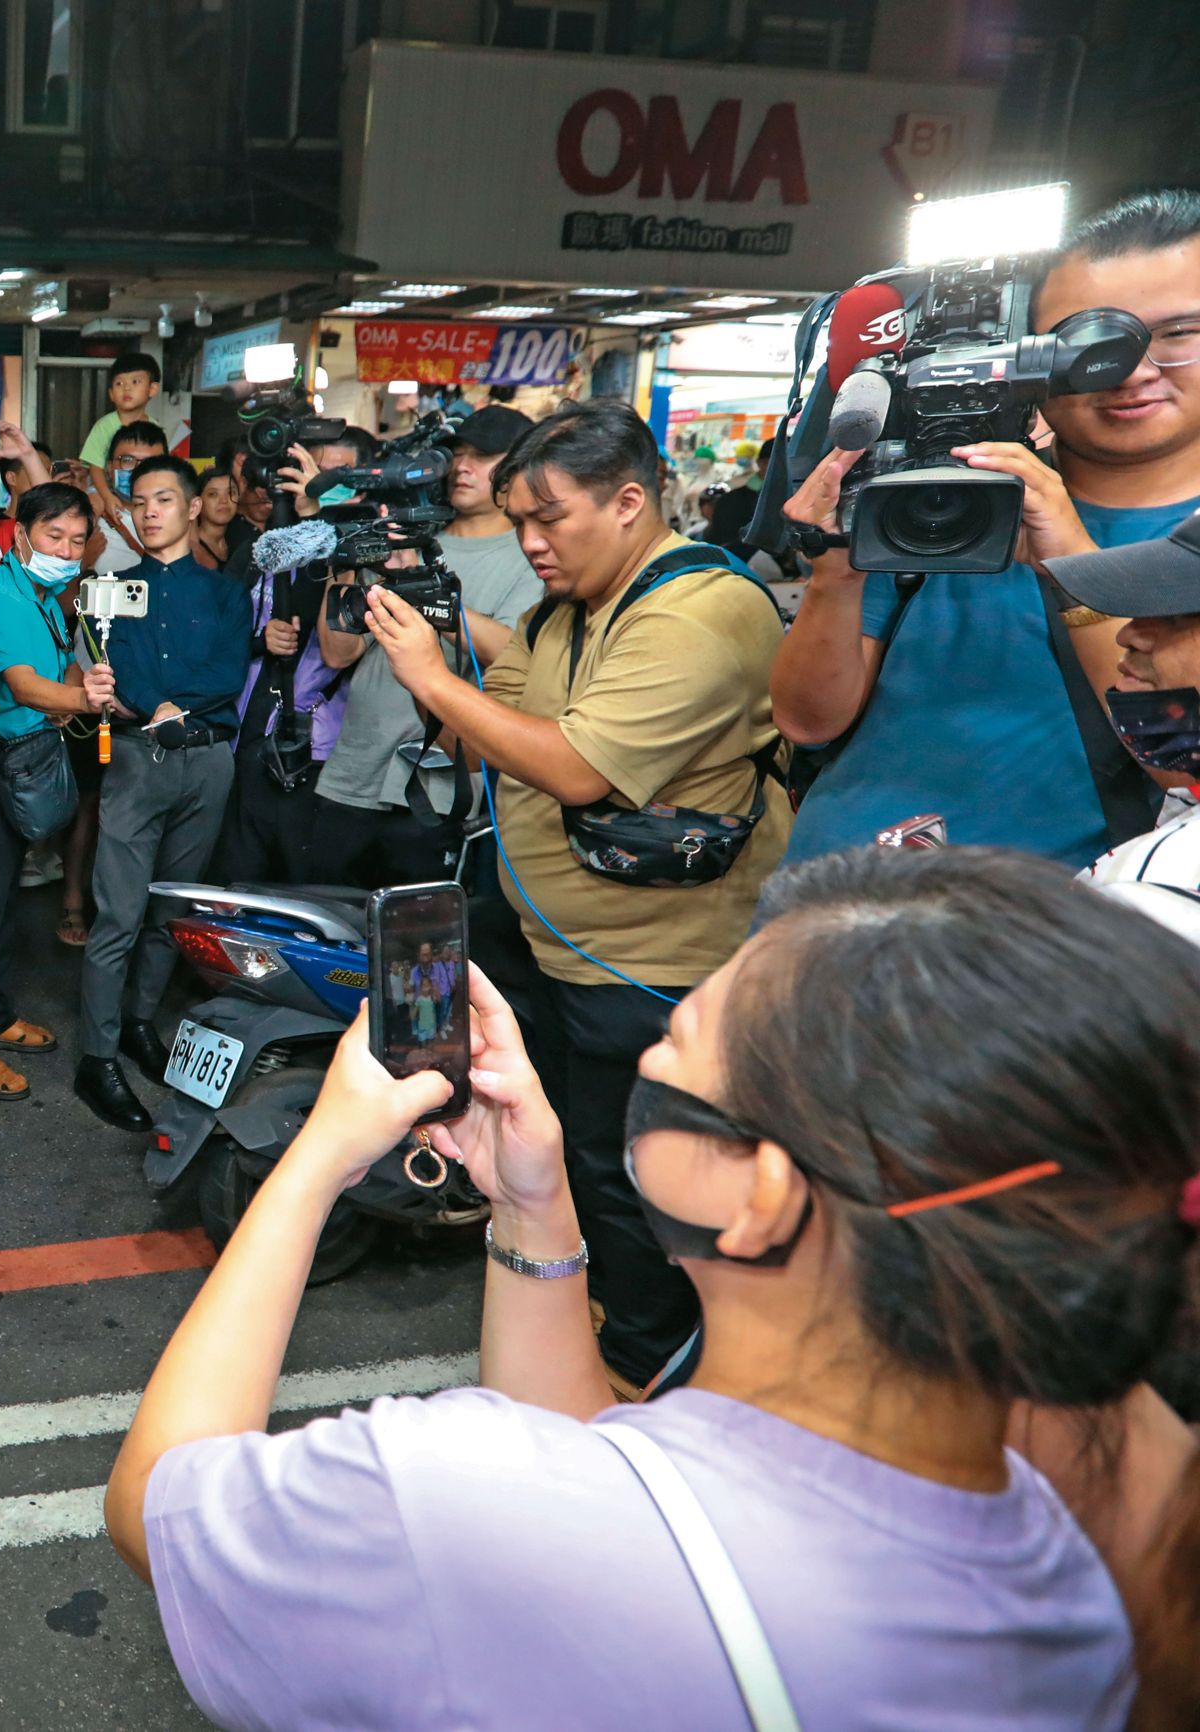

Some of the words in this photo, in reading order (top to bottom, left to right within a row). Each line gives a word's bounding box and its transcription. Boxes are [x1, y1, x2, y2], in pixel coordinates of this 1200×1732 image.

[557, 88, 809, 205] OMA
[910, 122, 953, 158] B1
[641, 216, 727, 249] fashion
[738, 224, 790, 254] mall
[358, 326, 399, 345] OMA
[423, 605, 450, 619] TVBS
